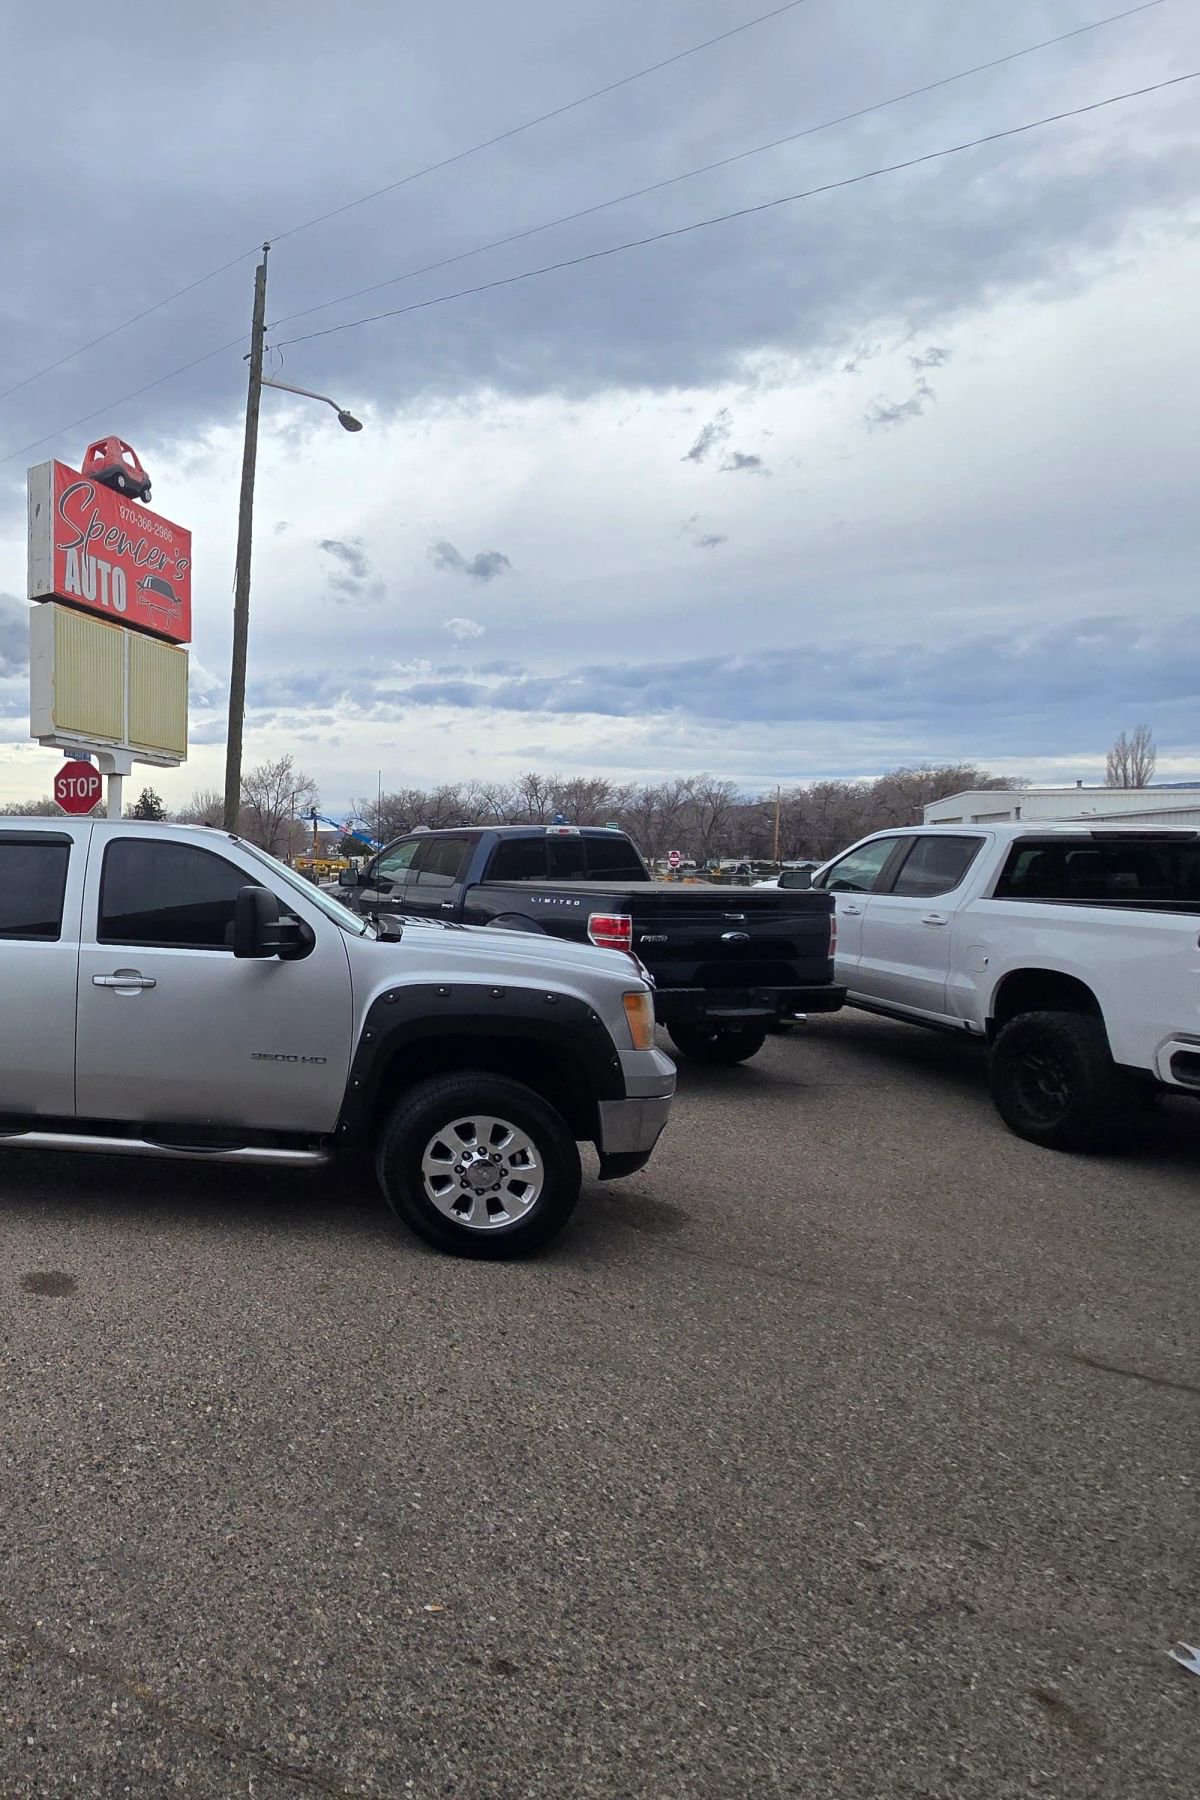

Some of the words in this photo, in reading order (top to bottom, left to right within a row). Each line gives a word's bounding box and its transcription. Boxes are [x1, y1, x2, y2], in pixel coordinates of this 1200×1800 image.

[57, 480, 189, 580] Spencer's
[64, 548, 127, 613] AUTO
[57, 777, 99, 799] STOP
[531, 897, 580, 906] LIMITED
